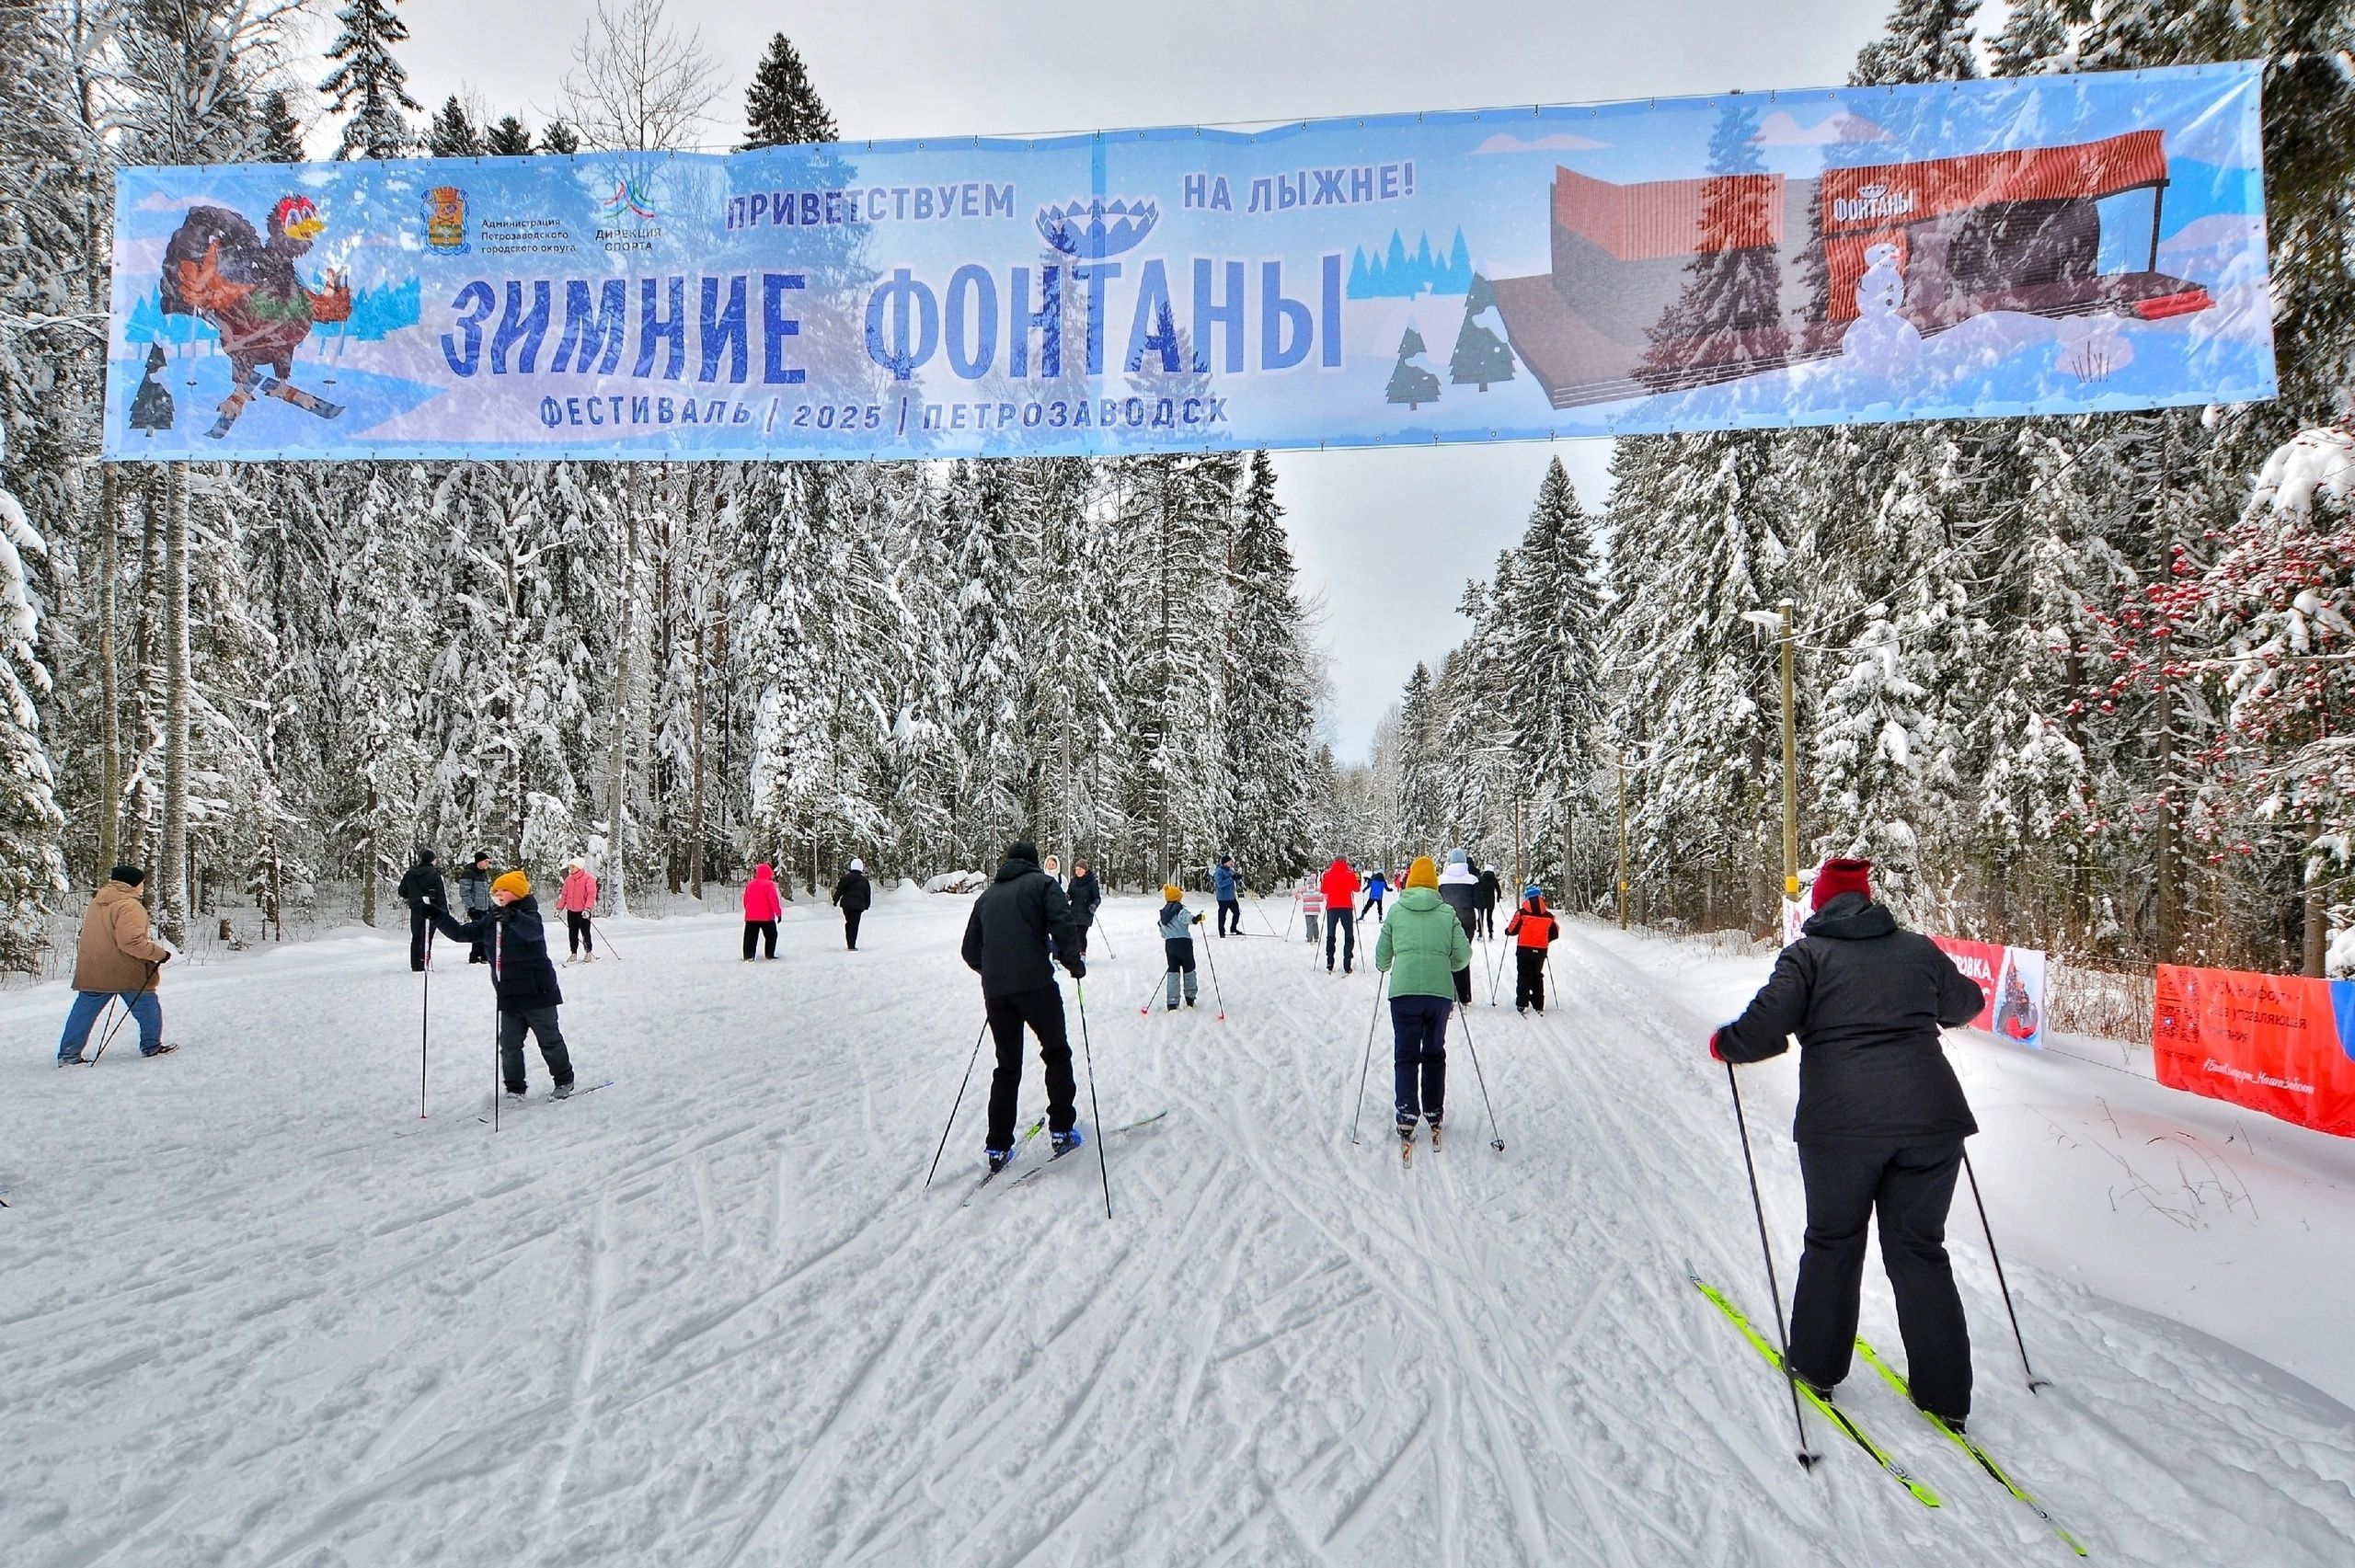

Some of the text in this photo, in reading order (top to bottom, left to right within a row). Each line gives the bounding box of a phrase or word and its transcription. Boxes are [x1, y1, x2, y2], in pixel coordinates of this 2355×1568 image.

[727, 162, 1415, 229] ПРИВЕТСТВУЕМ НА ЛЫЖНЕ!
[1833, 189, 1913, 223] ФОНТАНЫ
[481, 219, 561, 229] Администрация
[481, 232, 569, 242] Петрозаводского
[595, 227, 661, 240] ДИРЕКЦИЯ
[481, 244, 577, 255] городского округа
[604, 242, 652, 252] СПОРТА
[441, 254, 1342, 384] ЗИМНИЕ ФОНТАНЫ
[541, 395, 750, 429] ФЕСТИВАЛЬ
[793, 403, 881, 429] 2025
[923, 396, 1229, 430] ПЕТРОЗАВОДСК
